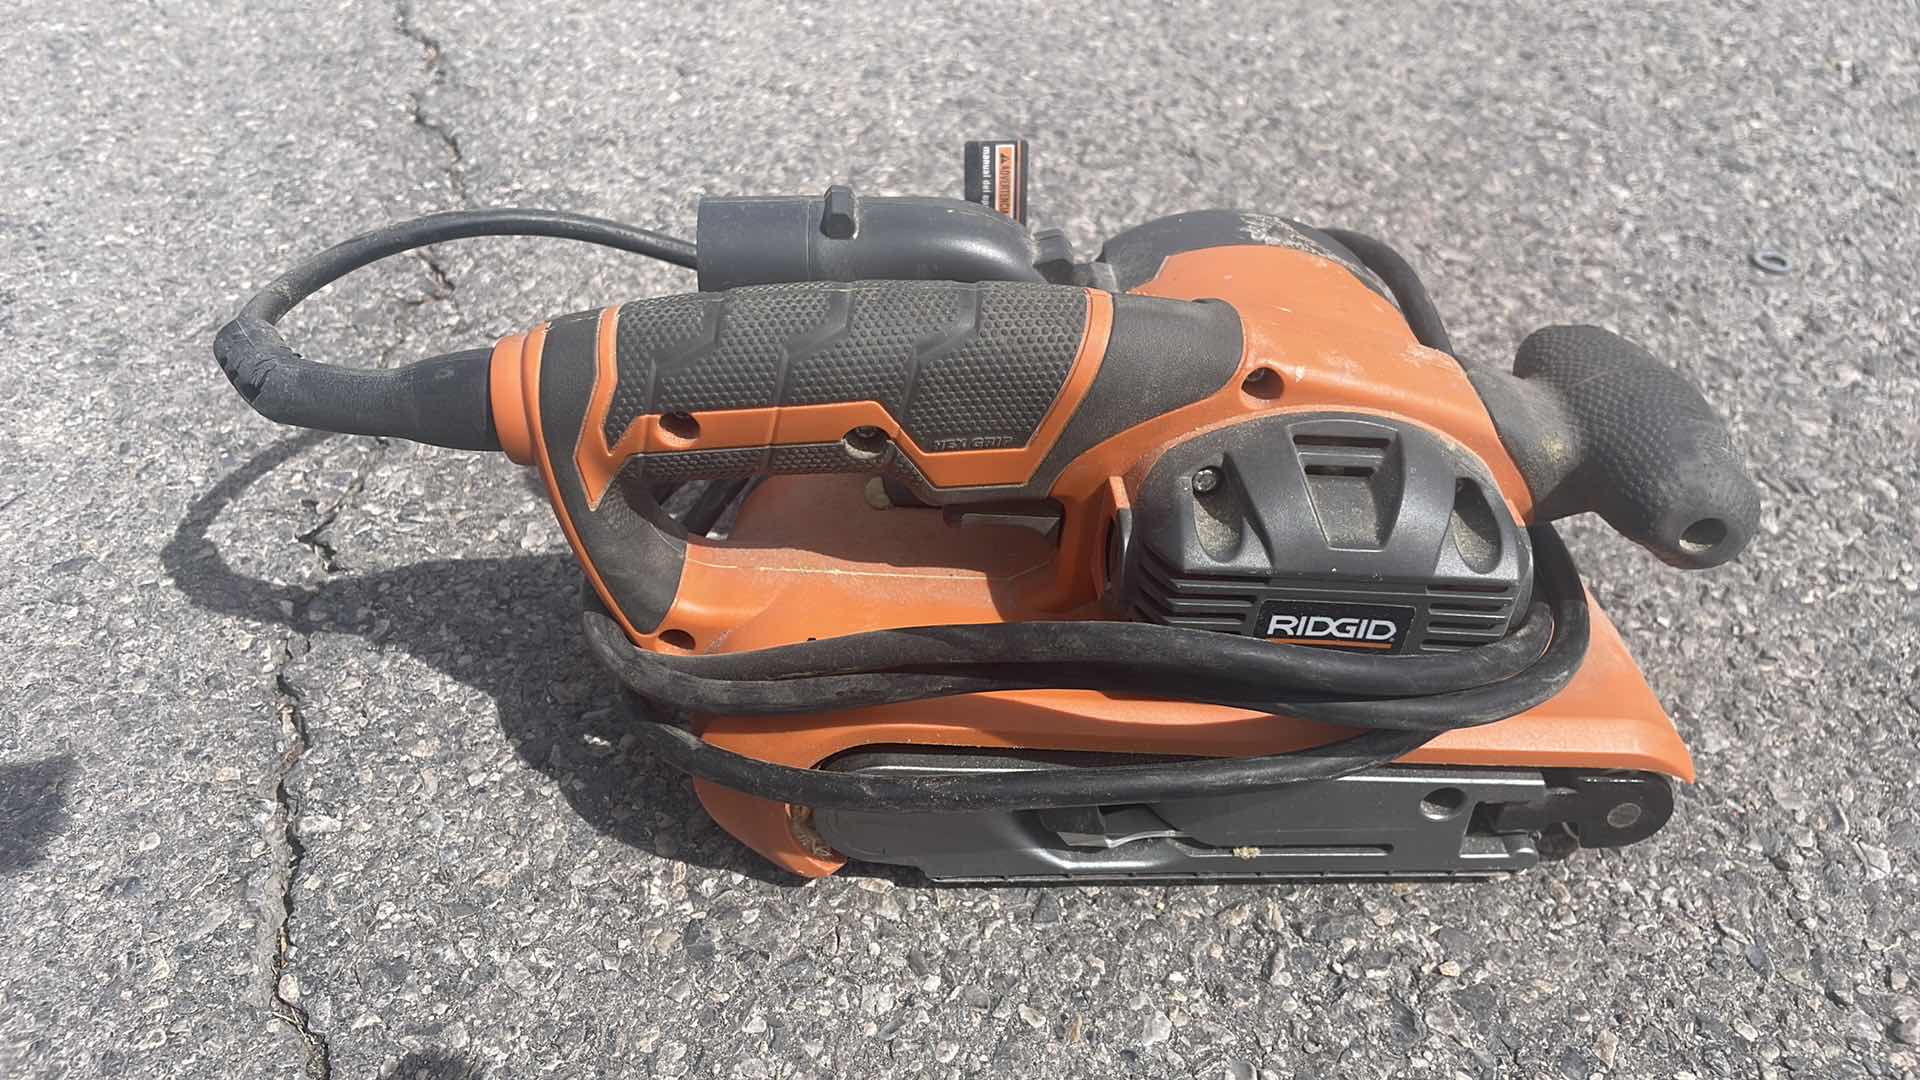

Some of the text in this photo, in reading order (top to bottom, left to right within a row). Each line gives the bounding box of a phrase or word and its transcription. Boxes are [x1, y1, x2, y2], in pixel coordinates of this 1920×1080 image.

[982, 146, 992, 178] manual
[982, 180, 992, 193] del
[972, 436, 1013, 448] GRIP
[1266, 610, 1397, 641] RIDGID
